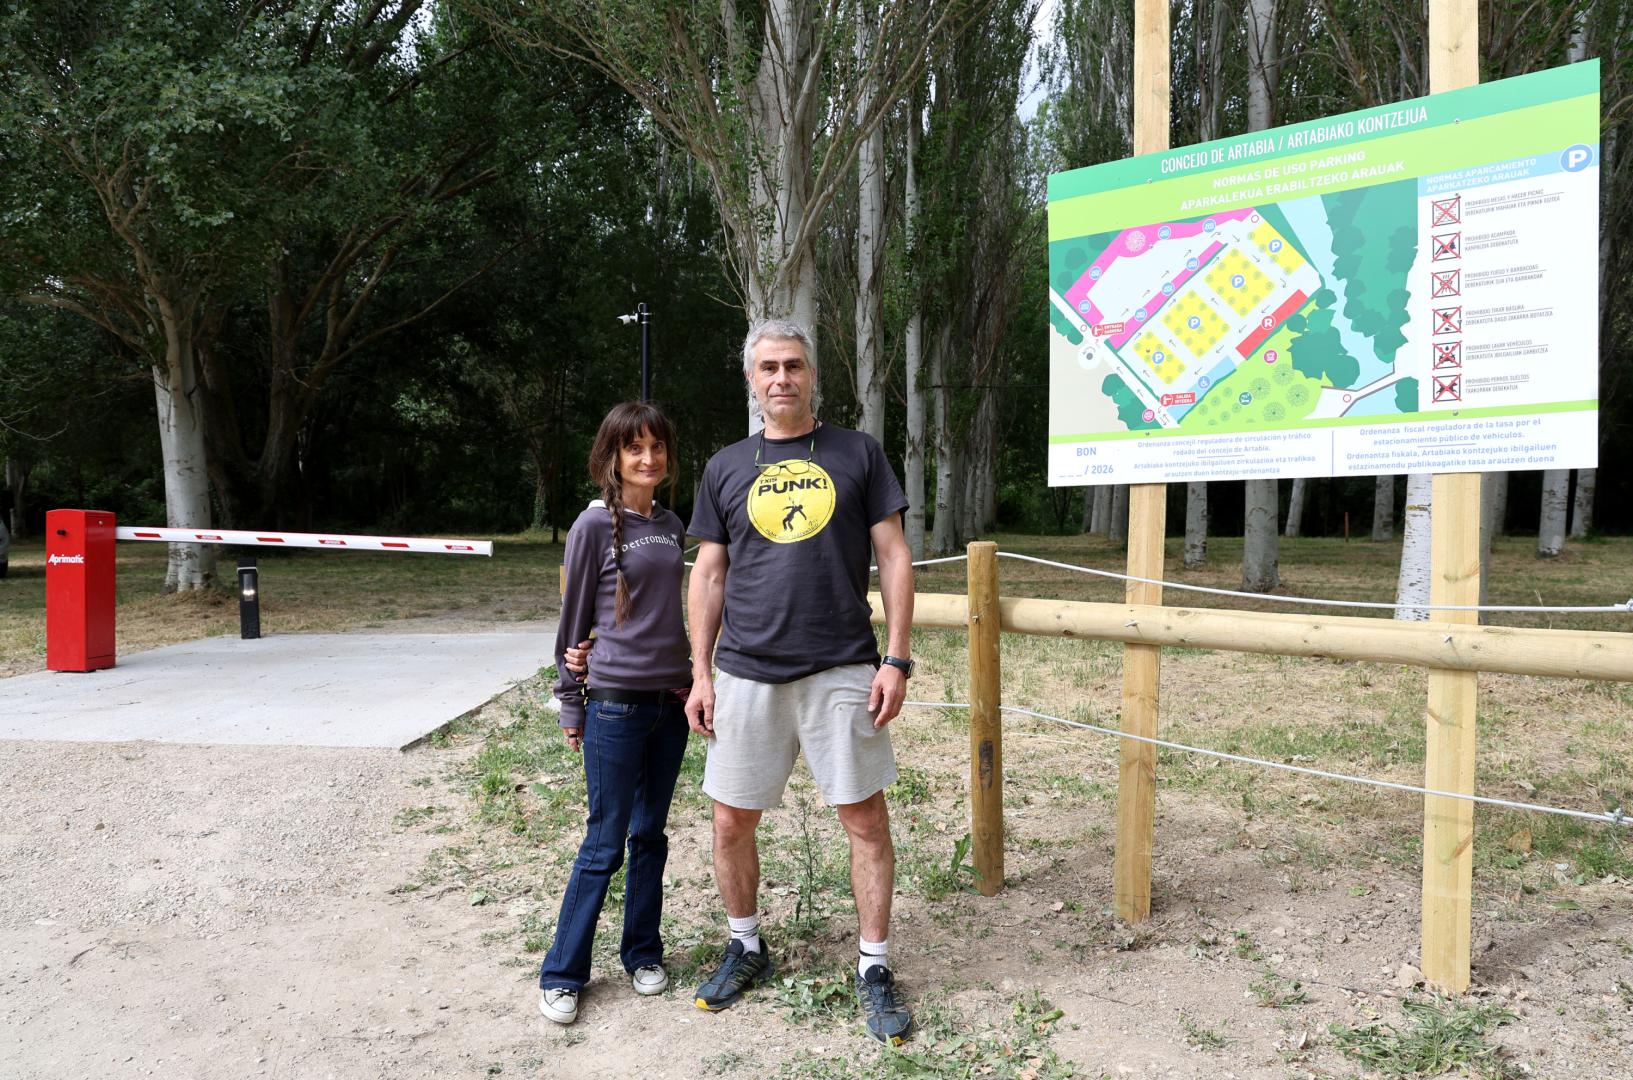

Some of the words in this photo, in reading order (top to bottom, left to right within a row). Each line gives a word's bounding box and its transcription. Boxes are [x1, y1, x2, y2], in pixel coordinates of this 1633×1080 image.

[1161, 150, 1207, 173] CONCEJO
[1212, 147, 1224, 163] DE
[1228, 137, 1274, 160] ARTABIA
[1288, 121, 1353, 148] ARTABIAKO
[1358, 106, 1427, 135] KONTZEJUA
[1568, 149, 1588, 169] P
[1213, 169, 1261, 188] NORMAS
[1265, 166, 1279, 179] DE
[1283, 161, 1306, 175] USO
[1310, 151, 1365, 171] PARKING
[1426, 171, 1464, 184] NORMAS
[1465, 158, 1536, 177] APARCAMIENTO
[1181, 186, 1263, 211] APARKALEKUA
[1267, 170, 1348, 195] ERABILTZEKO
[1352, 160, 1405, 180] ARAUAK
[1426, 176, 1488, 192] APARKATZEKO
[1491, 169, 1530, 182] ARAUAK
[1360, 426, 1400, 435] Ordenanza
[1404, 425, 1425, 433] fiscal
[1427, 422, 1471, 433] reguladora
[1496, 420, 1513, 428] tasa
[1516, 419, 1530, 428] por
[1374, 436, 1437, 446] estacionamiento
[1077, 447, 1096, 456] BON
[1092, 465, 1114, 474] 2026
[758, 478, 828, 496] PUNK!
[48, 554, 84, 566] Aprimatic
